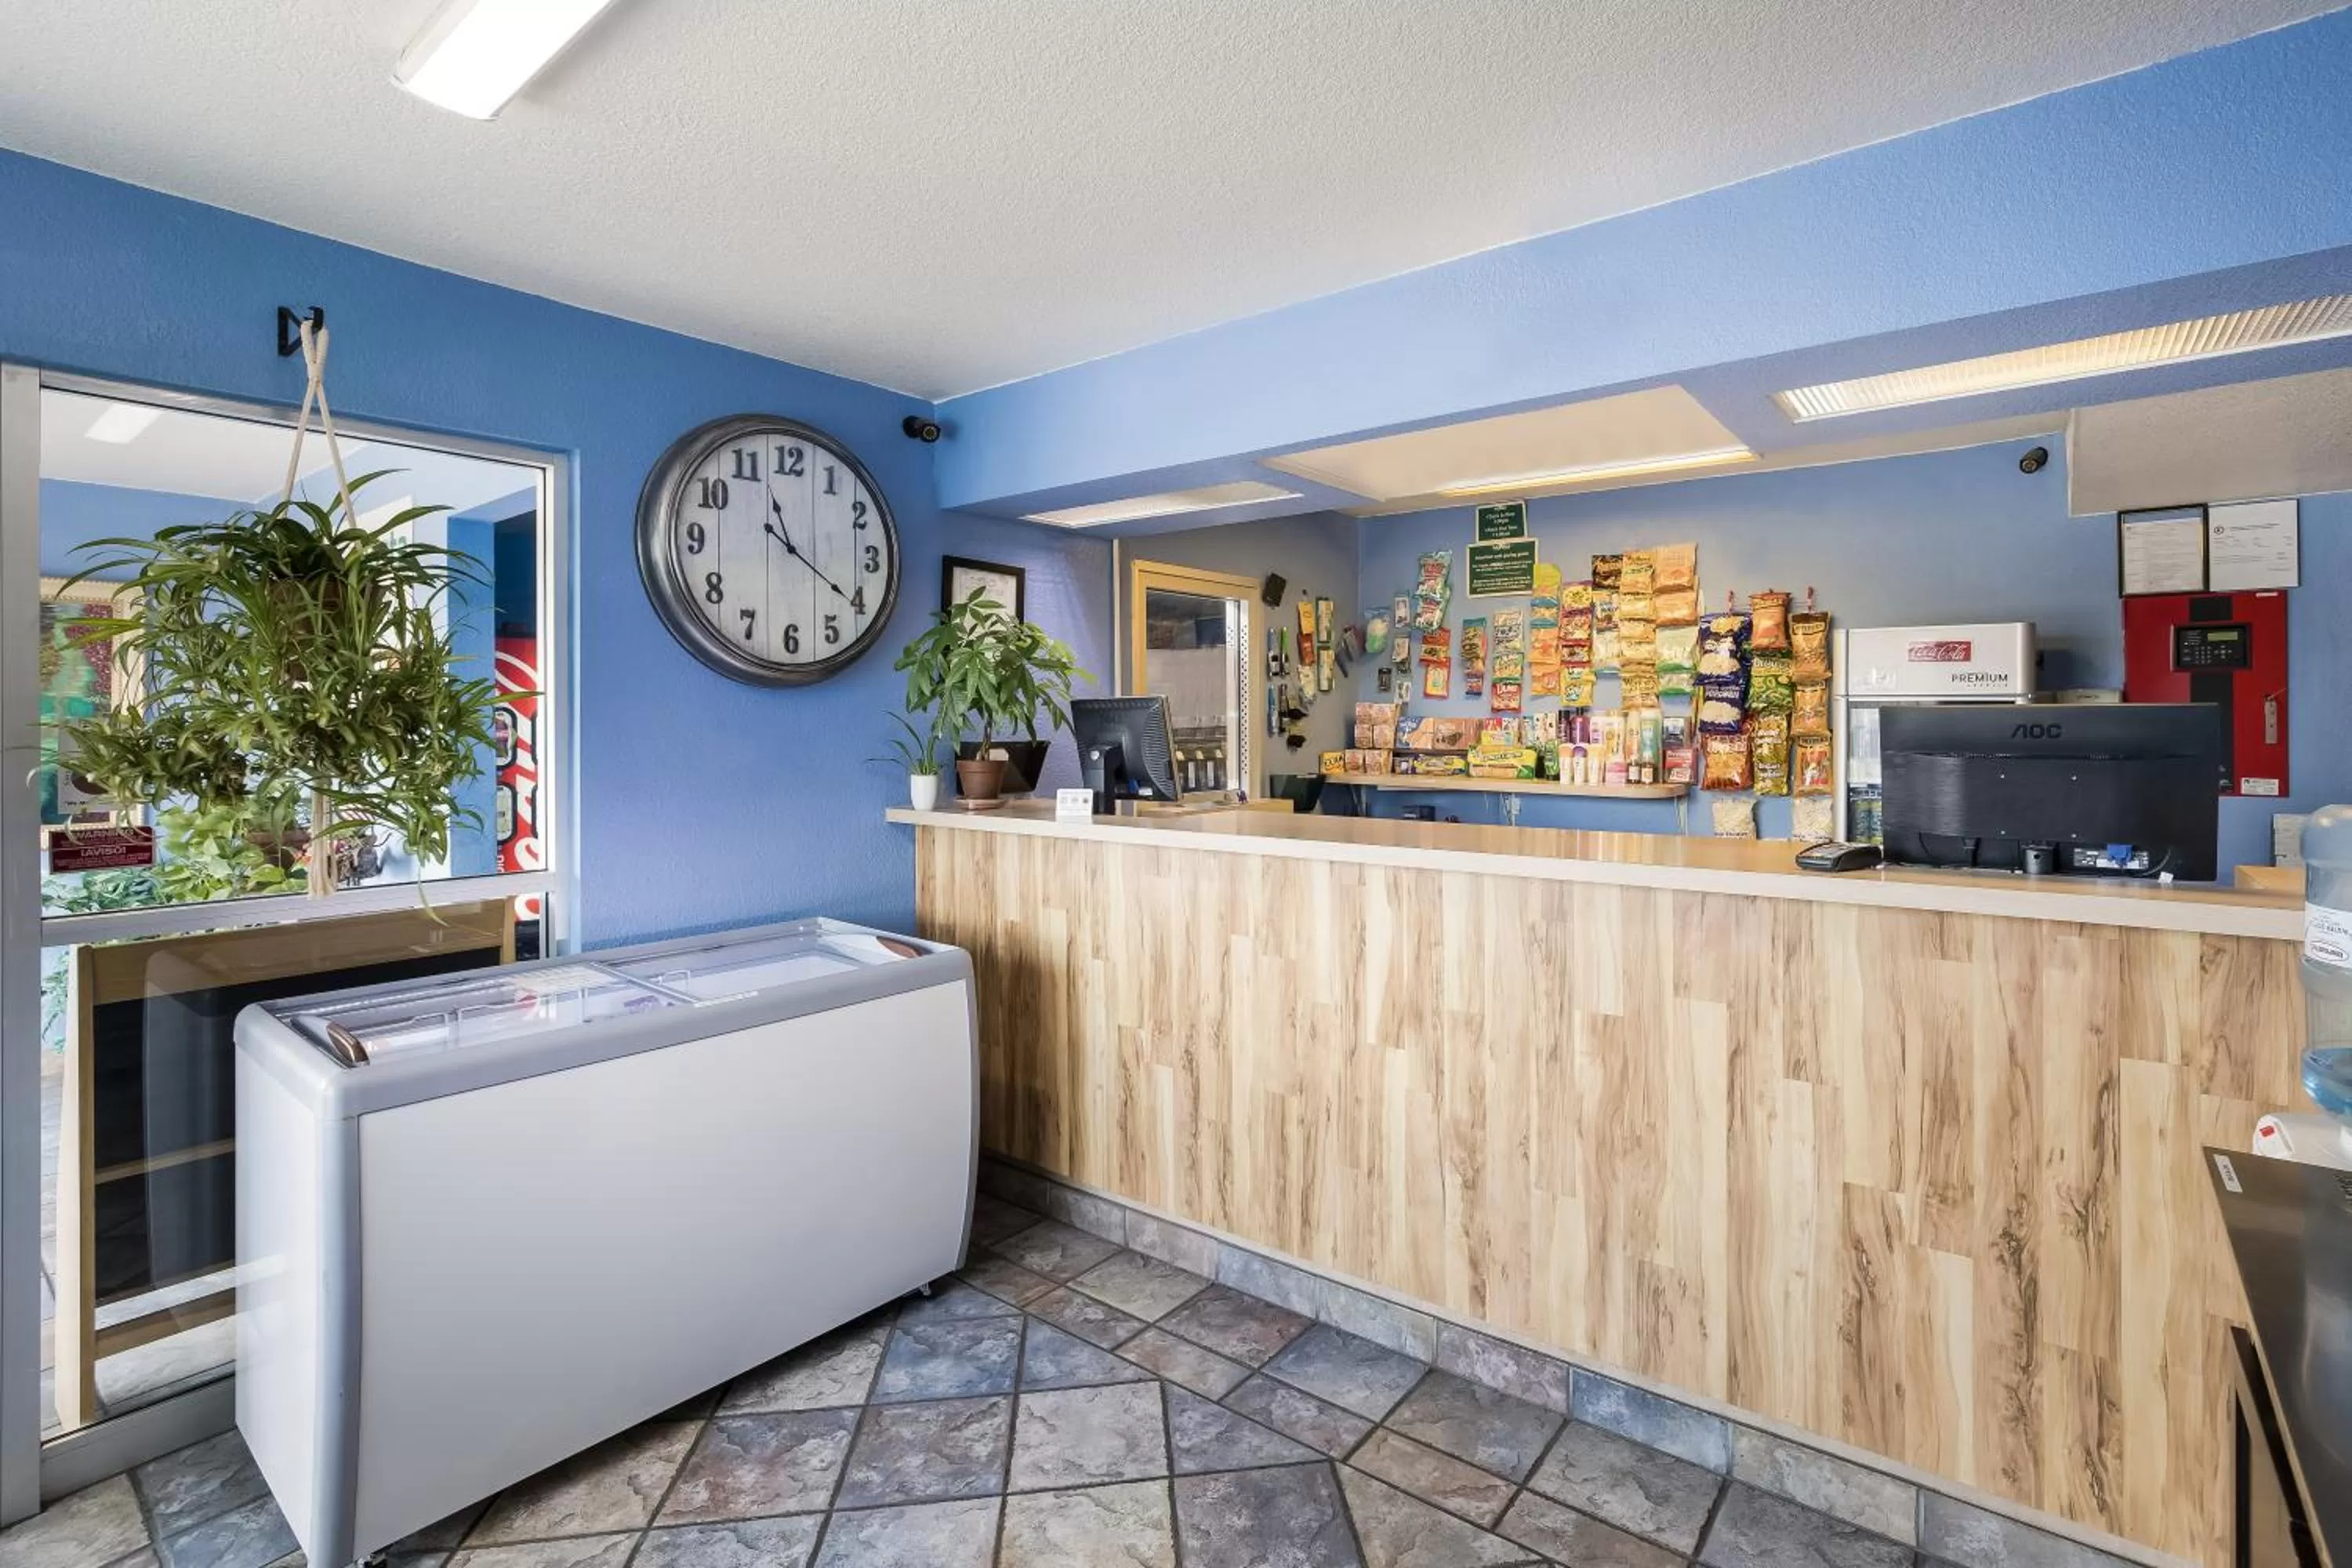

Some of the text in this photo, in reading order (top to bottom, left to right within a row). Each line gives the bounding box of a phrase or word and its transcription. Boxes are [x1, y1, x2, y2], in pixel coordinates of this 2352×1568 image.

[731, 448, 761, 482] 11
[774, 445, 804, 477] 12
[698, 477, 728, 510] 10
[823, 466, 837, 495] 1
[851, 501, 867, 530] 2
[686, 522, 705, 554] 9
[864, 545, 880, 573] 3
[706, 572, 724, 604] 8
[851, 586, 866, 615] 4
[740, 609, 755, 640] 7
[783, 624, 799, 654] 6
[824, 614, 840, 644] 5
[1951, 673, 2008, 682] PREMIUM
[2011, 724, 2063, 739] AOC
